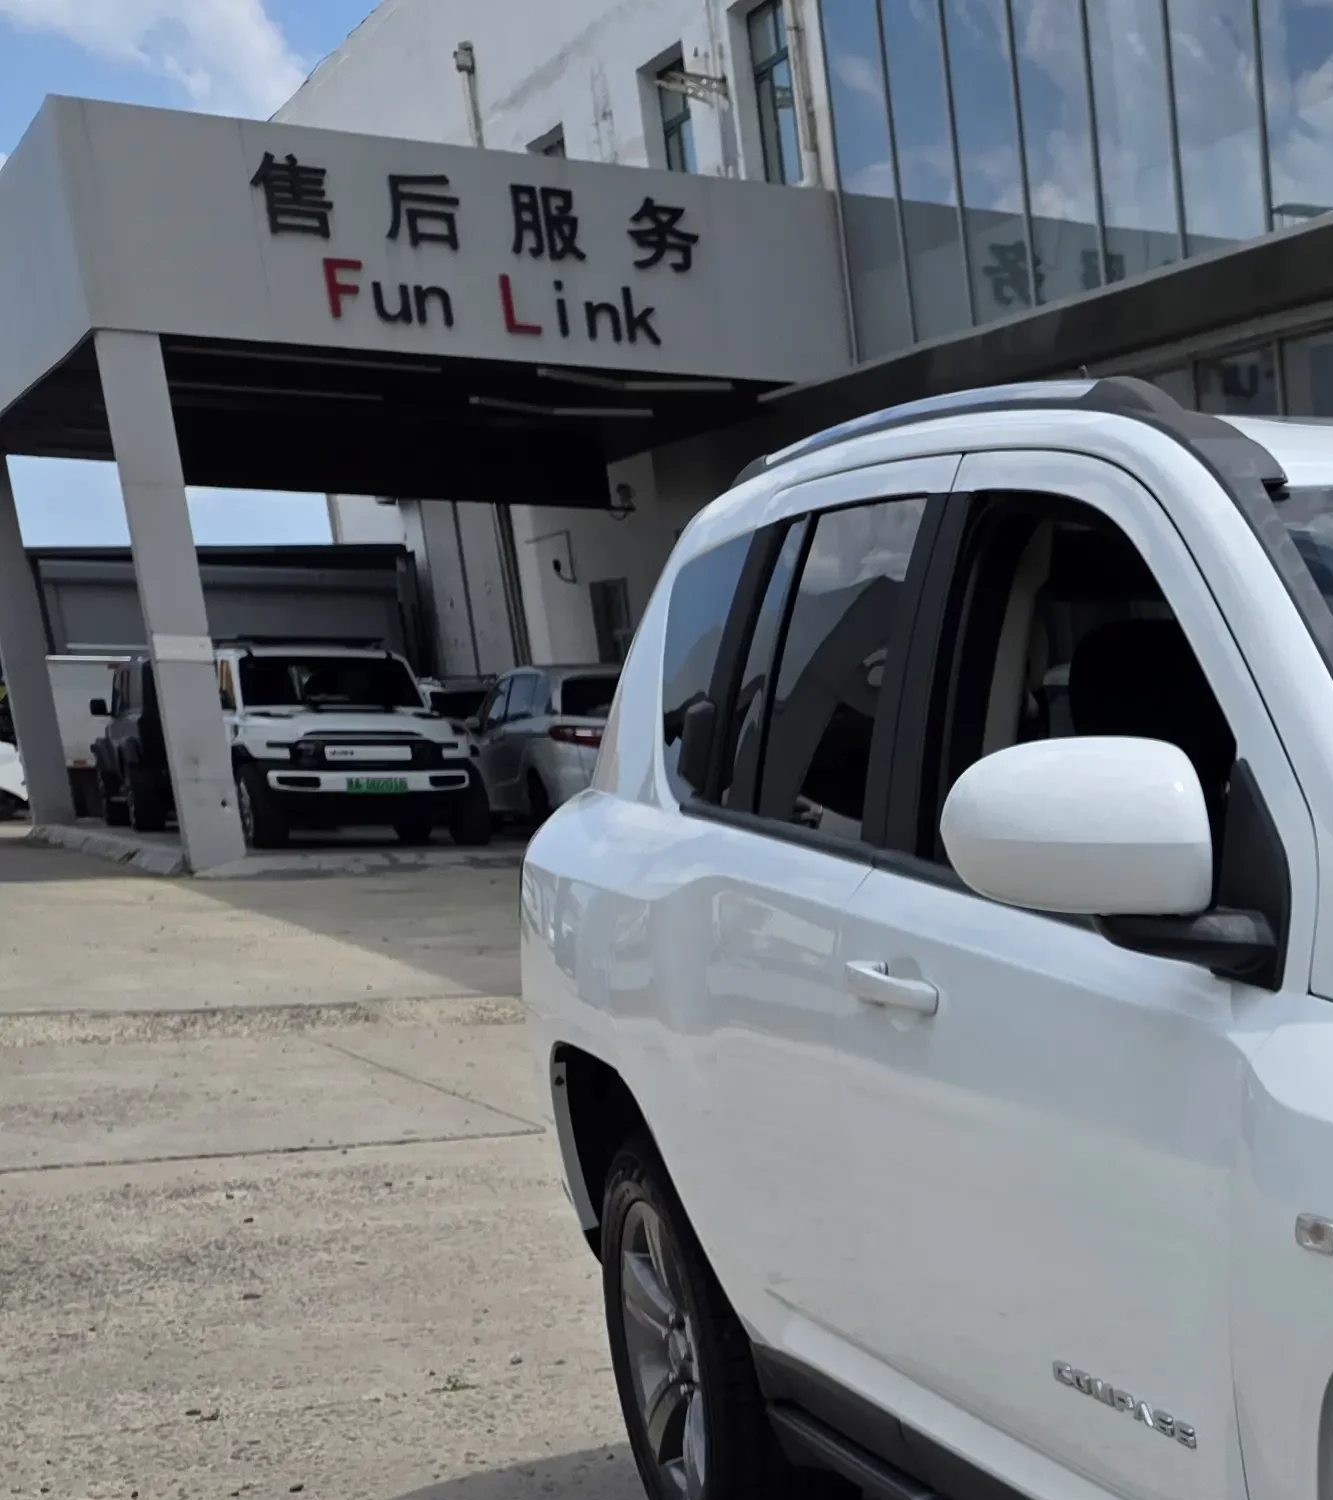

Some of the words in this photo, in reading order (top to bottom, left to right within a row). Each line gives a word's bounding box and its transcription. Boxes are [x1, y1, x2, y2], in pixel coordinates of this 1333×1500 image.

[250, 151, 700, 273] 售后服务
[322, 257, 455, 329] Fun
[498, 273, 662, 347] Link
